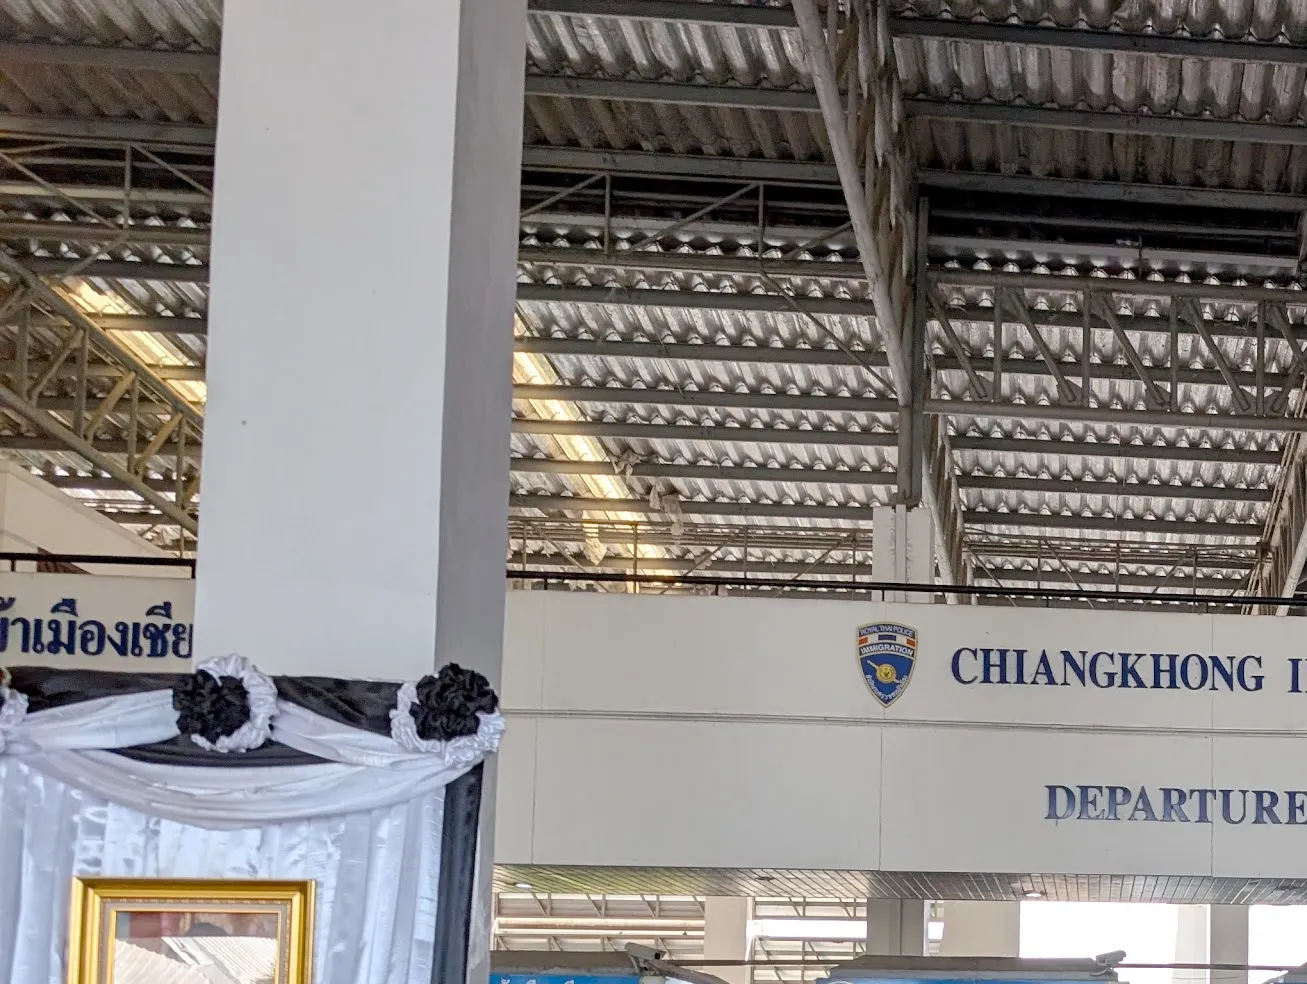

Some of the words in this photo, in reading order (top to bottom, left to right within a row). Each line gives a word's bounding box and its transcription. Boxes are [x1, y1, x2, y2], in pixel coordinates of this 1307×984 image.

[879, 625, 893, 633] THAI
[893, 625, 914, 637] POLICE
[861, 643, 914, 656] IMMIGRATION
[951, 647, 1265, 693] CHIANGKHONG
